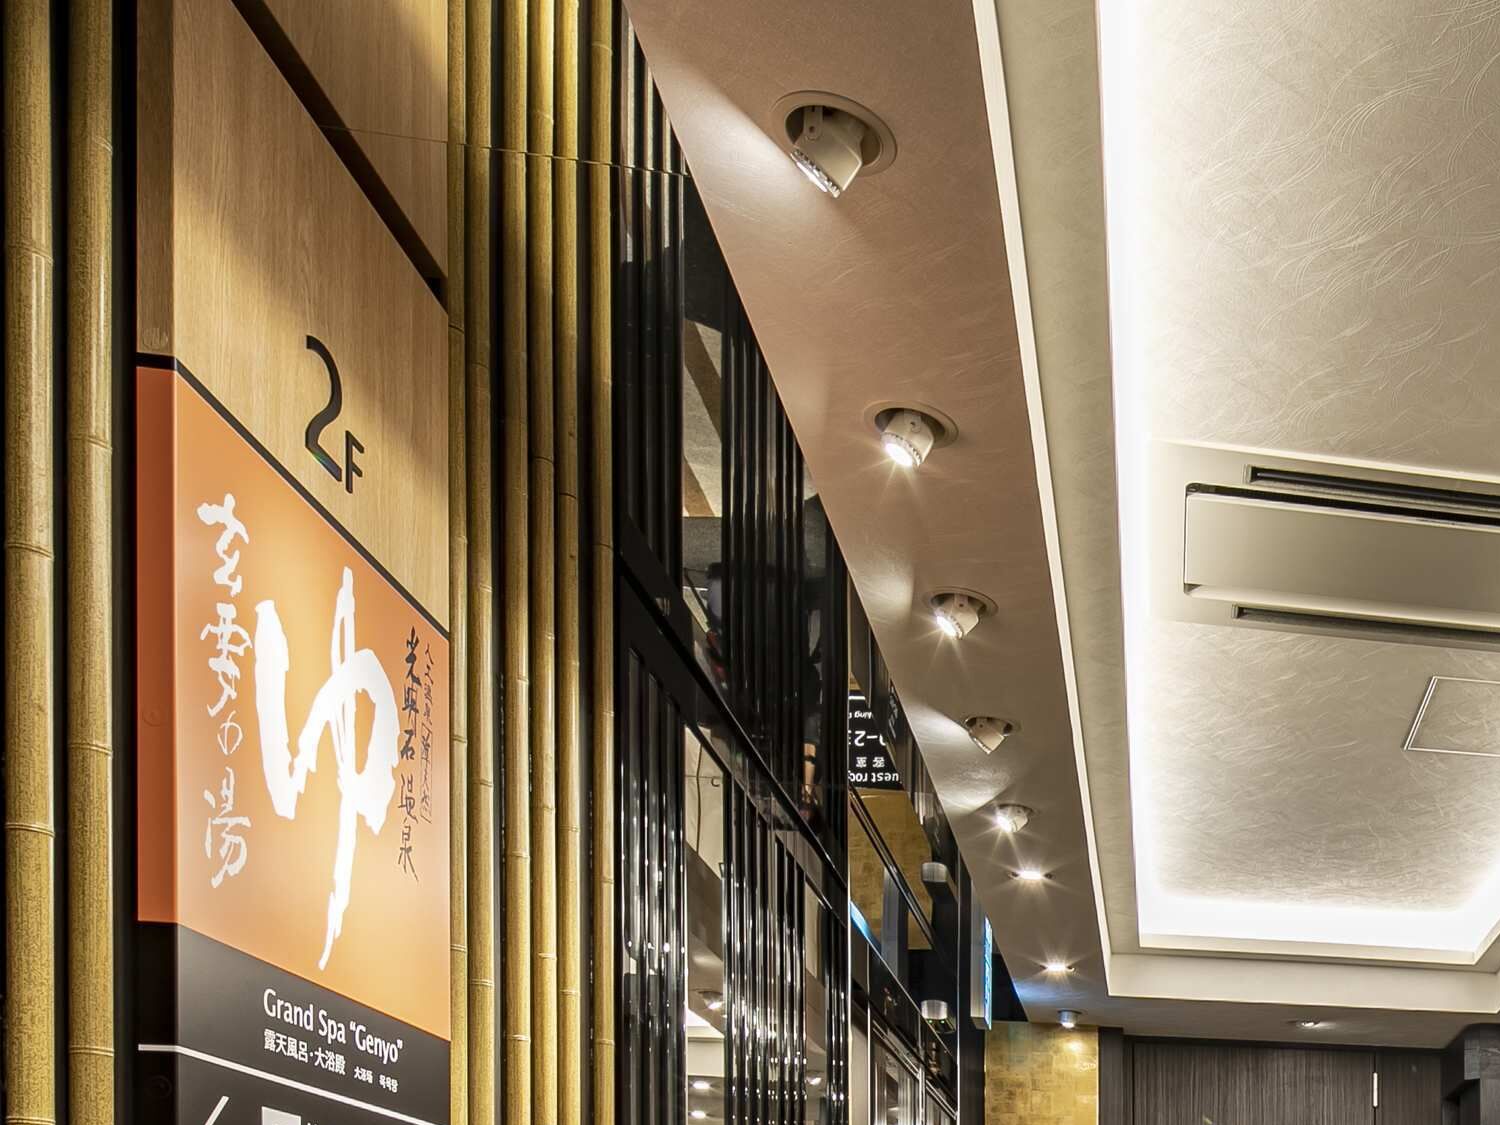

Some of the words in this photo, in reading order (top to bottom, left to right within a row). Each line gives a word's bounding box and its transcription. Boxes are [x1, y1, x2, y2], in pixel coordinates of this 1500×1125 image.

[305, 334, 365, 494] 2F
[254, 566, 400, 971] ゆ
[871, 772, 899, 782] uest
[263, 988, 314, 1031] Grand
[318, 1009, 346, 1045] Spa
